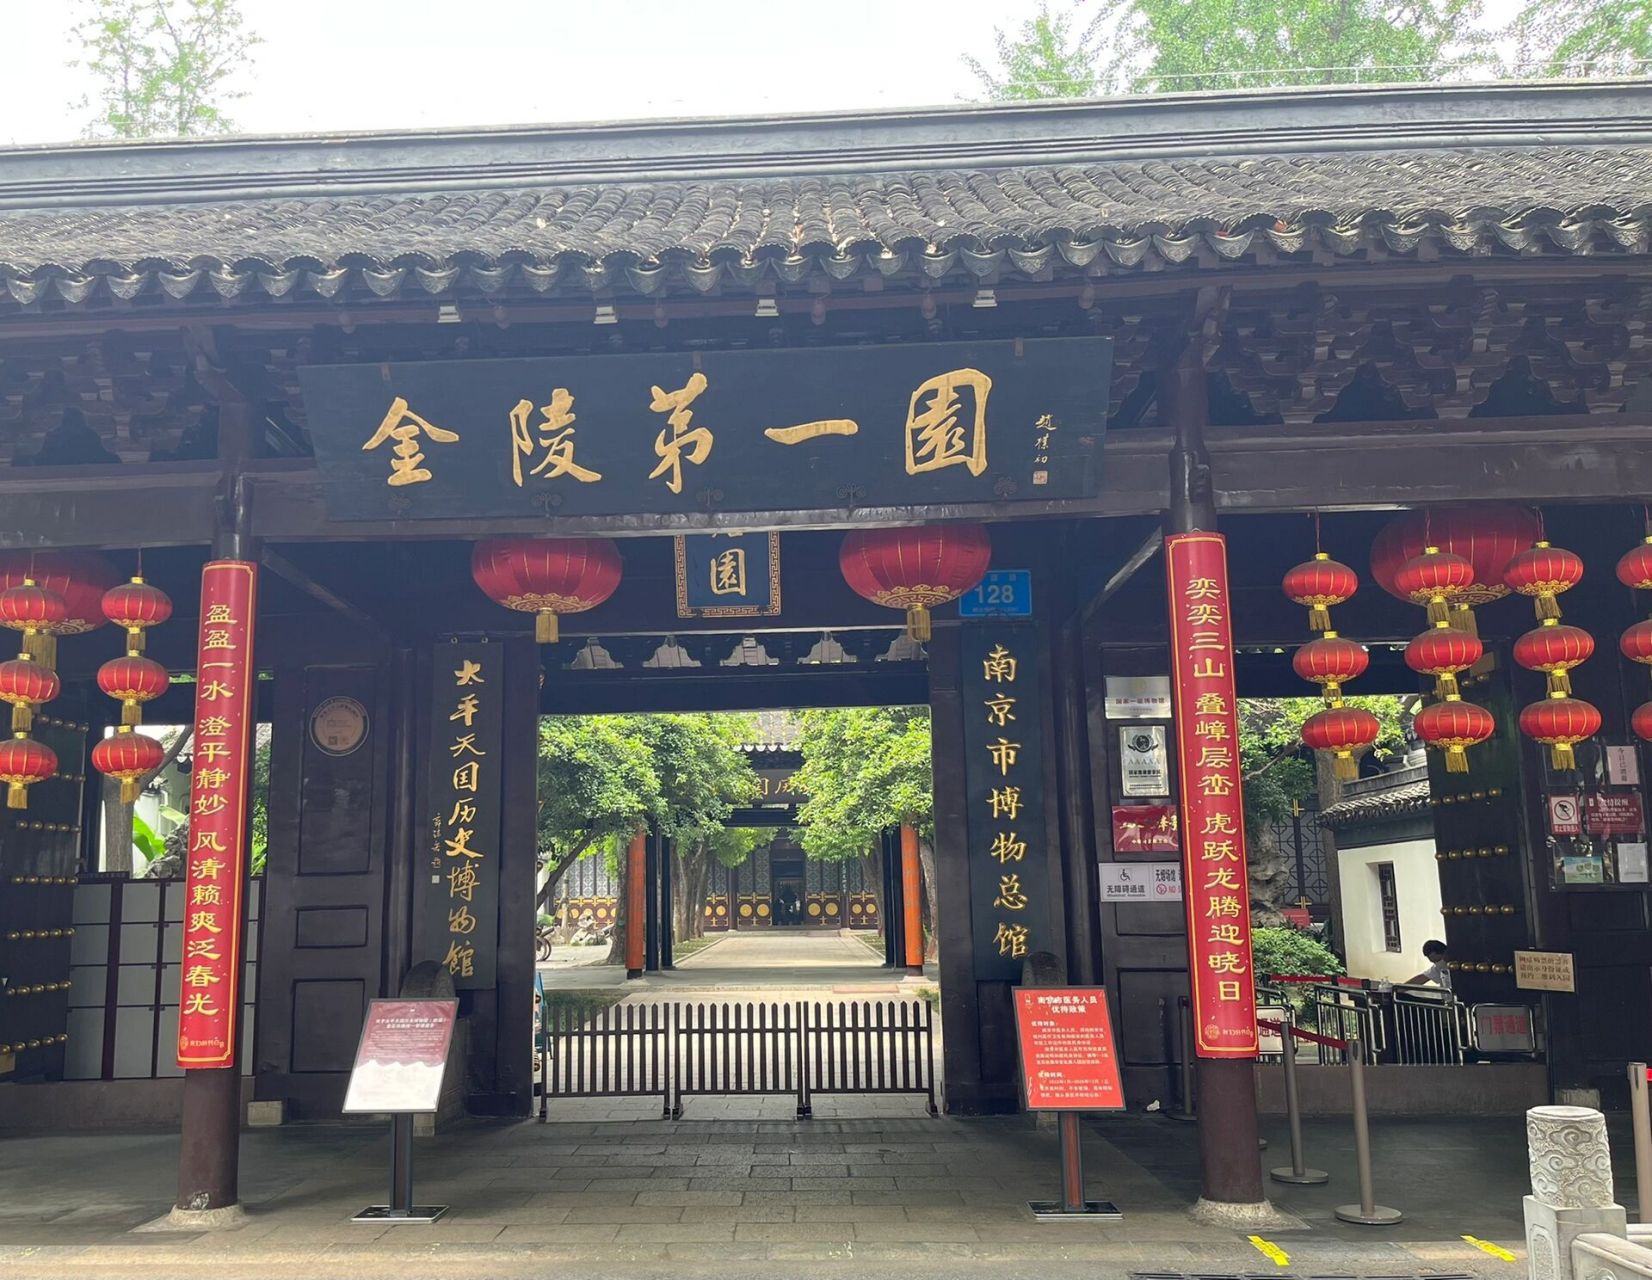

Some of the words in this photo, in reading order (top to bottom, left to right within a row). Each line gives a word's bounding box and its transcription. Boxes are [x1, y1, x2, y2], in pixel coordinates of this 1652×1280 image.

[974, 584, 1014, 604] 128
[982, 644, 1030, 960] 南京市博物总馆
[1107, 885, 1145, 893] 无障碍通道
